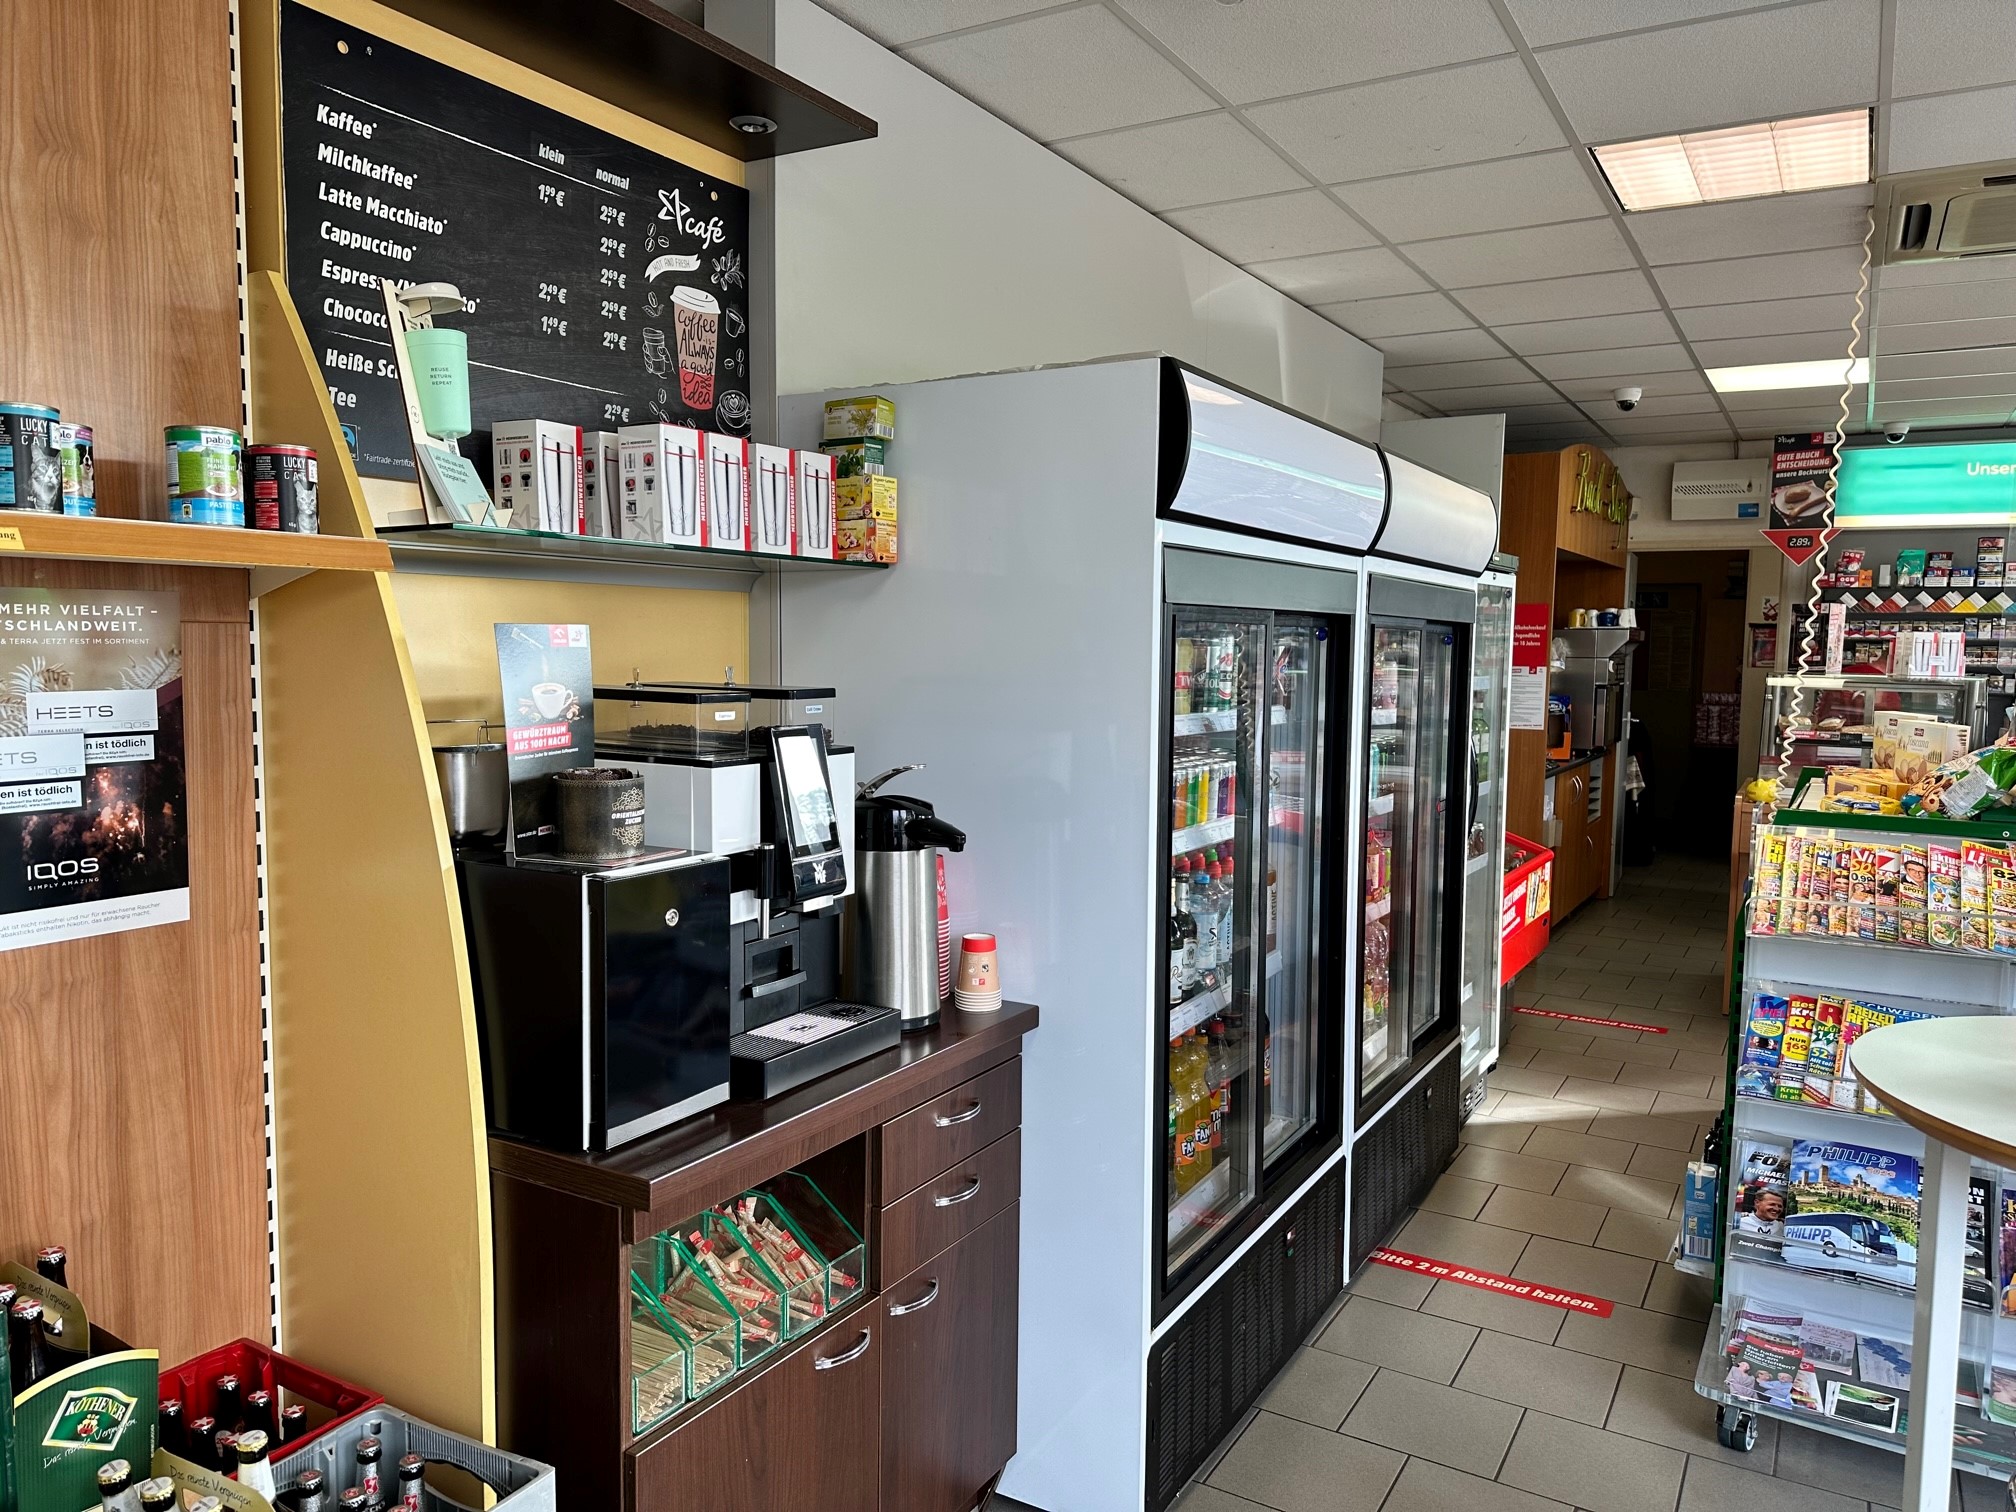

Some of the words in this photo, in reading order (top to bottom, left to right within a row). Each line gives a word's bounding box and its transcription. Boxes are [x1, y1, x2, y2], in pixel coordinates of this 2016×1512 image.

[538, 142, 566, 166] klein
[595, 167, 630, 191] normal
[318, 181, 363, 212] Latte
[685, 216, 727, 250] café
[652, 260, 663, 273] HOT
[664, 257, 675, 268] AND
[675, 257, 691, 269] FRESH
[326, 348, 374, 375] Heiße
[328, 386, 358, 408] Tee
[20, 417, 48, 433] LUCKY
[21, 435, 49, 447] CAT
[206, 435, 231, 446] pablo
[283, 456, 306, 469] LUCKY
[1776, 453, 1795, 462] GUTE
[1795, 450, 1820, 460] BAUCH
[1776, 457, 1830, 470] ENTSCHEIDUNG
[1775, 470, 1797, 479] unsere
[576, 455, 585, 519] MEHRWEGBECHER
[698, 459, 707, 522] MEHRWEGBECHER
[0, 603, 50, 615] MEHR
[60, 604, 145, 617] VIELFALT
[36, 705, 114, 720] HEETS
[121, 721, 151, 730] IQOS
[512, 724, 567, 741] GEWÜRZTRAUM
[95, 740, 109, 749] ist
[111, 738, 147, 749] tödlich
[514, 740, 529, 751] AUS
[530, 737, 548, 749] 1001
[547, 735, 570, 747] NACHT
[45, 766, 78, 776] IQOS
[18, 787, 32, 797] ist
[35, 784, 73, 796] tödlich
[1931, 851, 1961, 866] aktue
[27, 857, 100, 881] IQOS
[1931, 861, 1960, 878] Fra
[28, 882, 59, 892] SIMPLY
[62, 876, 100, 887] AMAZING
[20, 920, 37, 929] nicht
[38, 917, 65, 927] risikofrei
[101, 906, 136, 917] erwachsene
[137, 902, 161, 911] Raucher
[0, 928, 35, 939] abaksticks
[36, 923, 65, 933] enthalten
[103, 913, 131, 923] abhängig
[1848, 1003, 1896, 1024] FREIZEIT
[1569, 1015, 1618, 1026] Abstand
[1618, 1022, 1660, 1033] halten.
[1788, 1036, 1807, 1044] NUR
[1806, 1145, 1898, 1170] PHILIPP
[1746, 1166, 1787, 1179] MICHAEL
[1757, 1176, 1790, 1187] SEBAS
[1785, 1226, 1833, 1243] PHILIPP
[1371, 1249, 1414, 1267] Bitte
[1415, 1261, 1430, 1271] 2
[1430, 1265, 1450, 1275] m
[1450, 1269, 1532, 1294] Abstand
[1531, 1287, 1600, 1311] halten.
[1745, 1348, 1765, 1359] Spaß
[1765, 1354, 1779, 1362] am
[1746, 1344, 1759, 1352] Sie
[1759, 1348, 1785, 1360] haben
[1744, 1351, 1796, 1371] Unterrichten?
